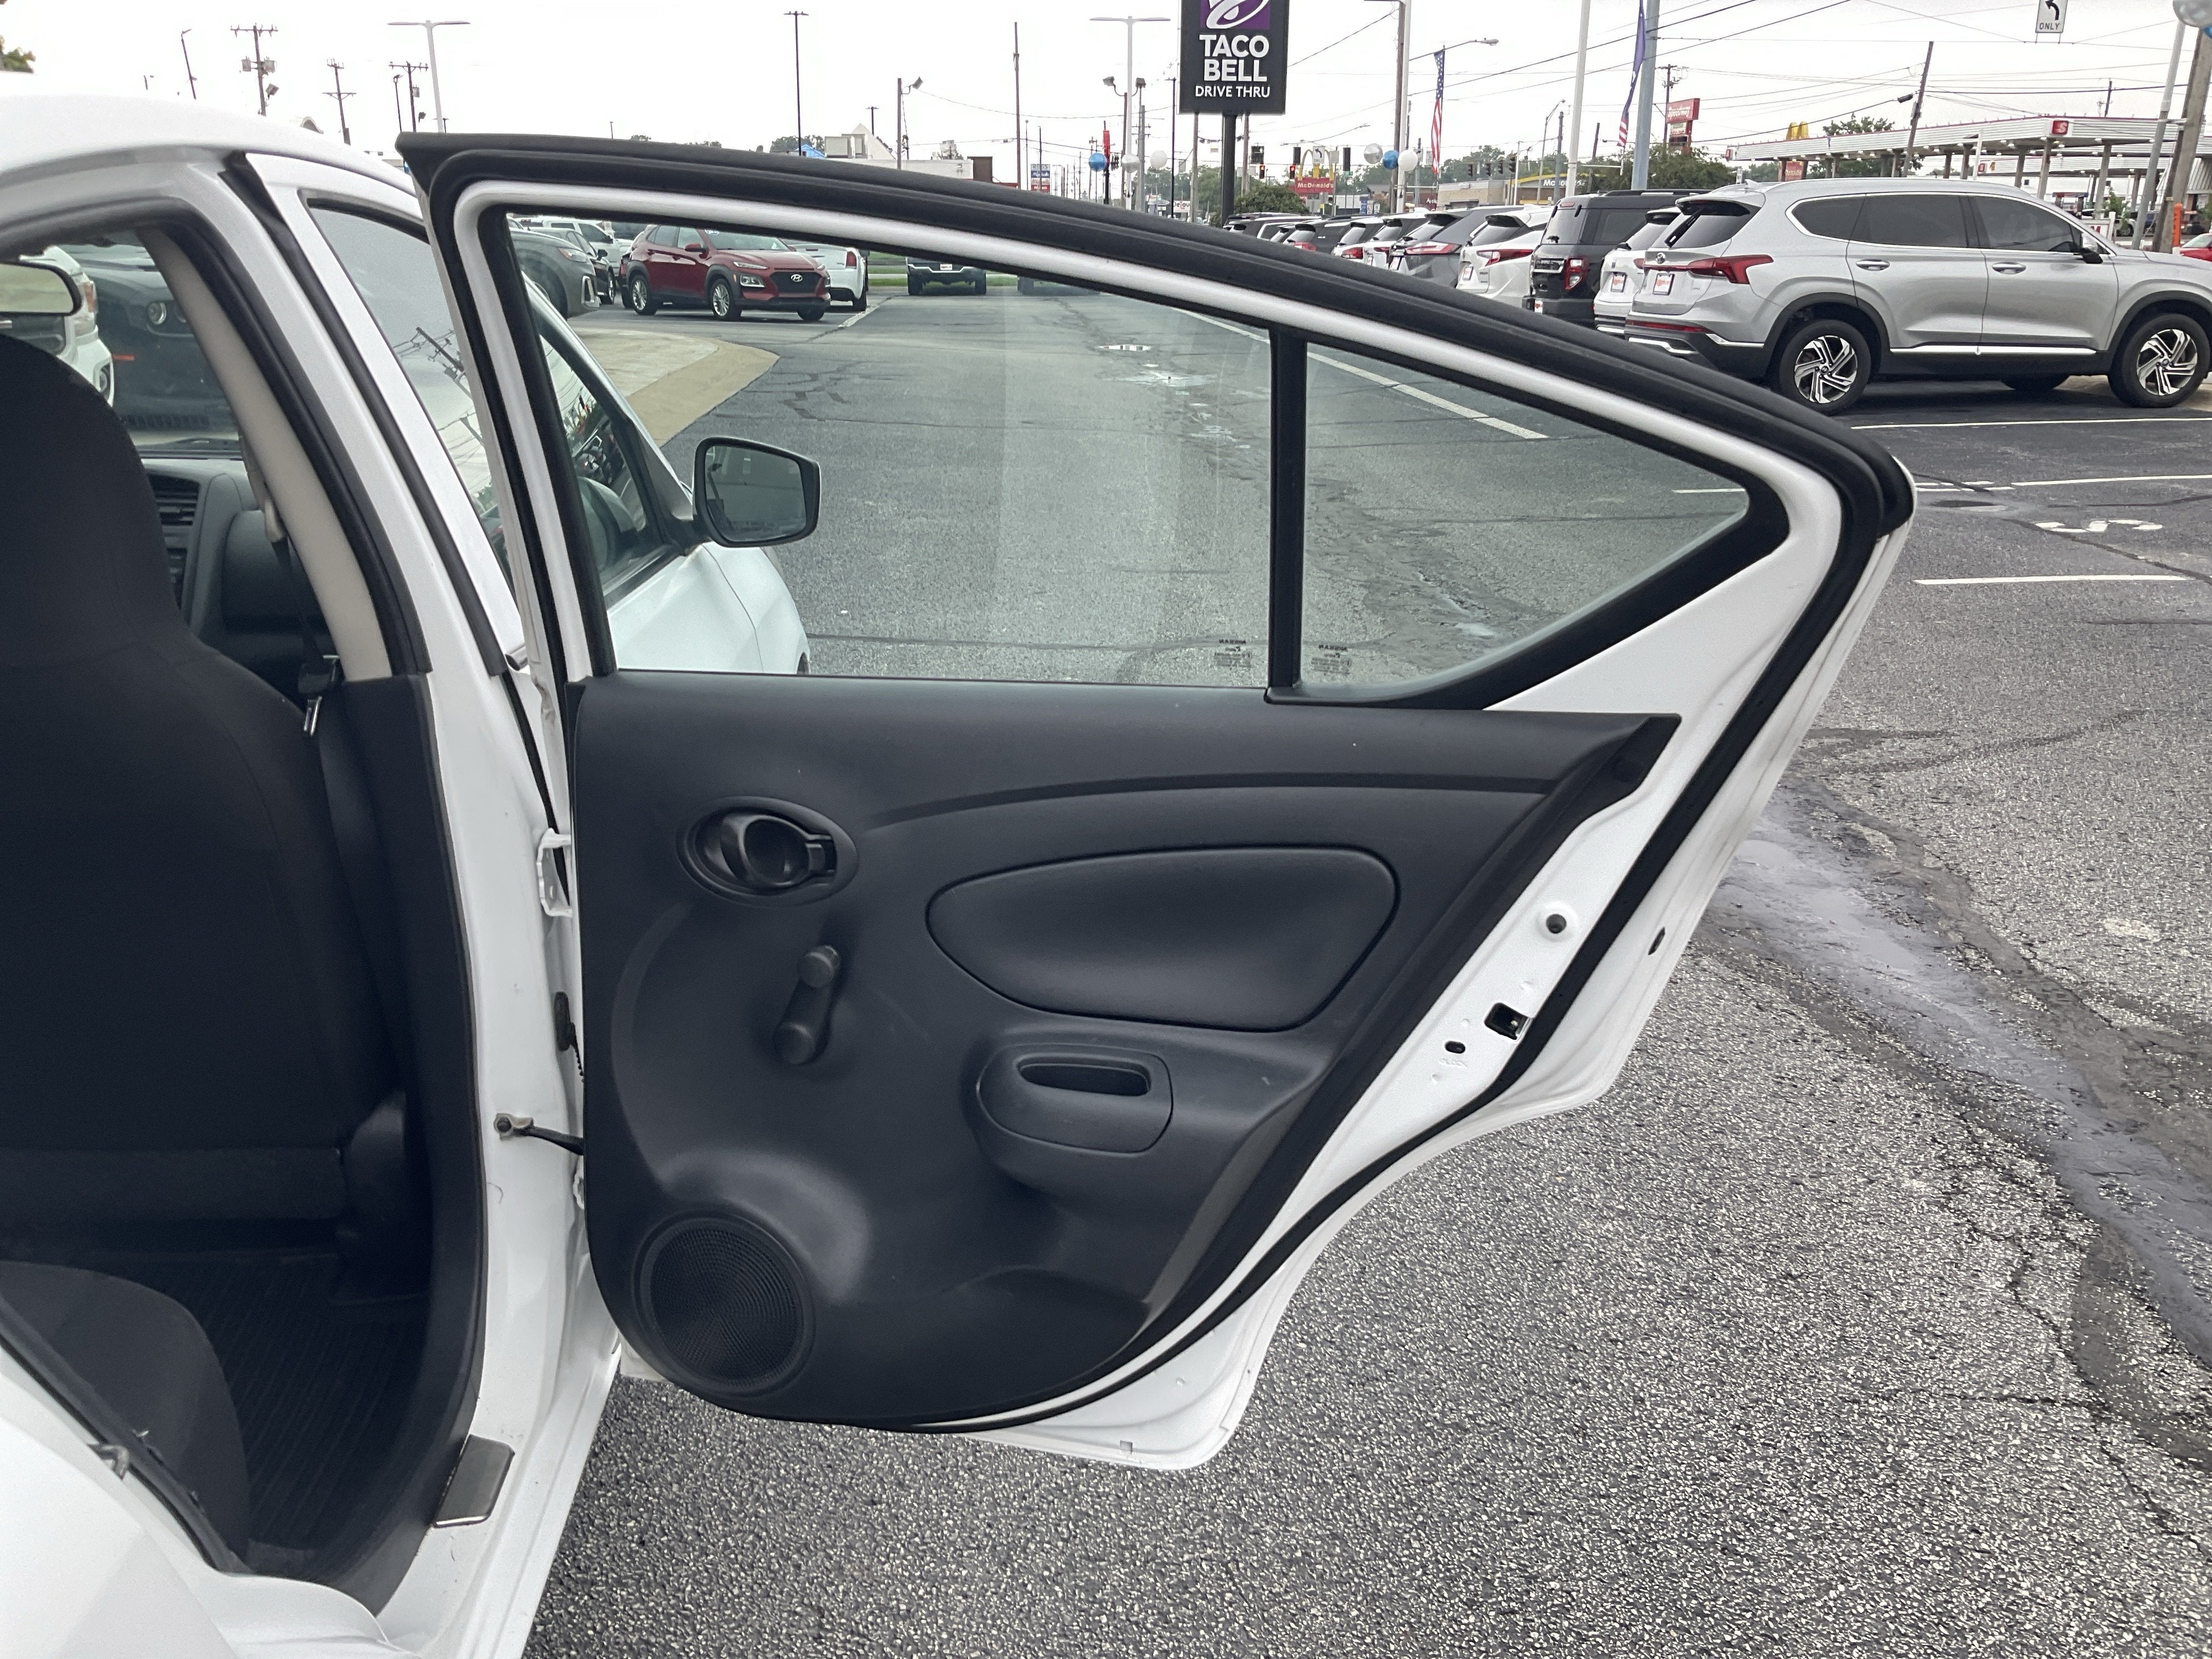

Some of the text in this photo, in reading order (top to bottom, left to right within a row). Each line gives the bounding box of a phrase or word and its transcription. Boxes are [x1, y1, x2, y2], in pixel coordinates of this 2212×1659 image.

[2039, 22, 2060, 30] ONLY
[1199, 34, 1269, 58] TACO
[1204, 59, 1267, 82] BELL
[1195, 86, 1270, 98] DRIVE THRU
